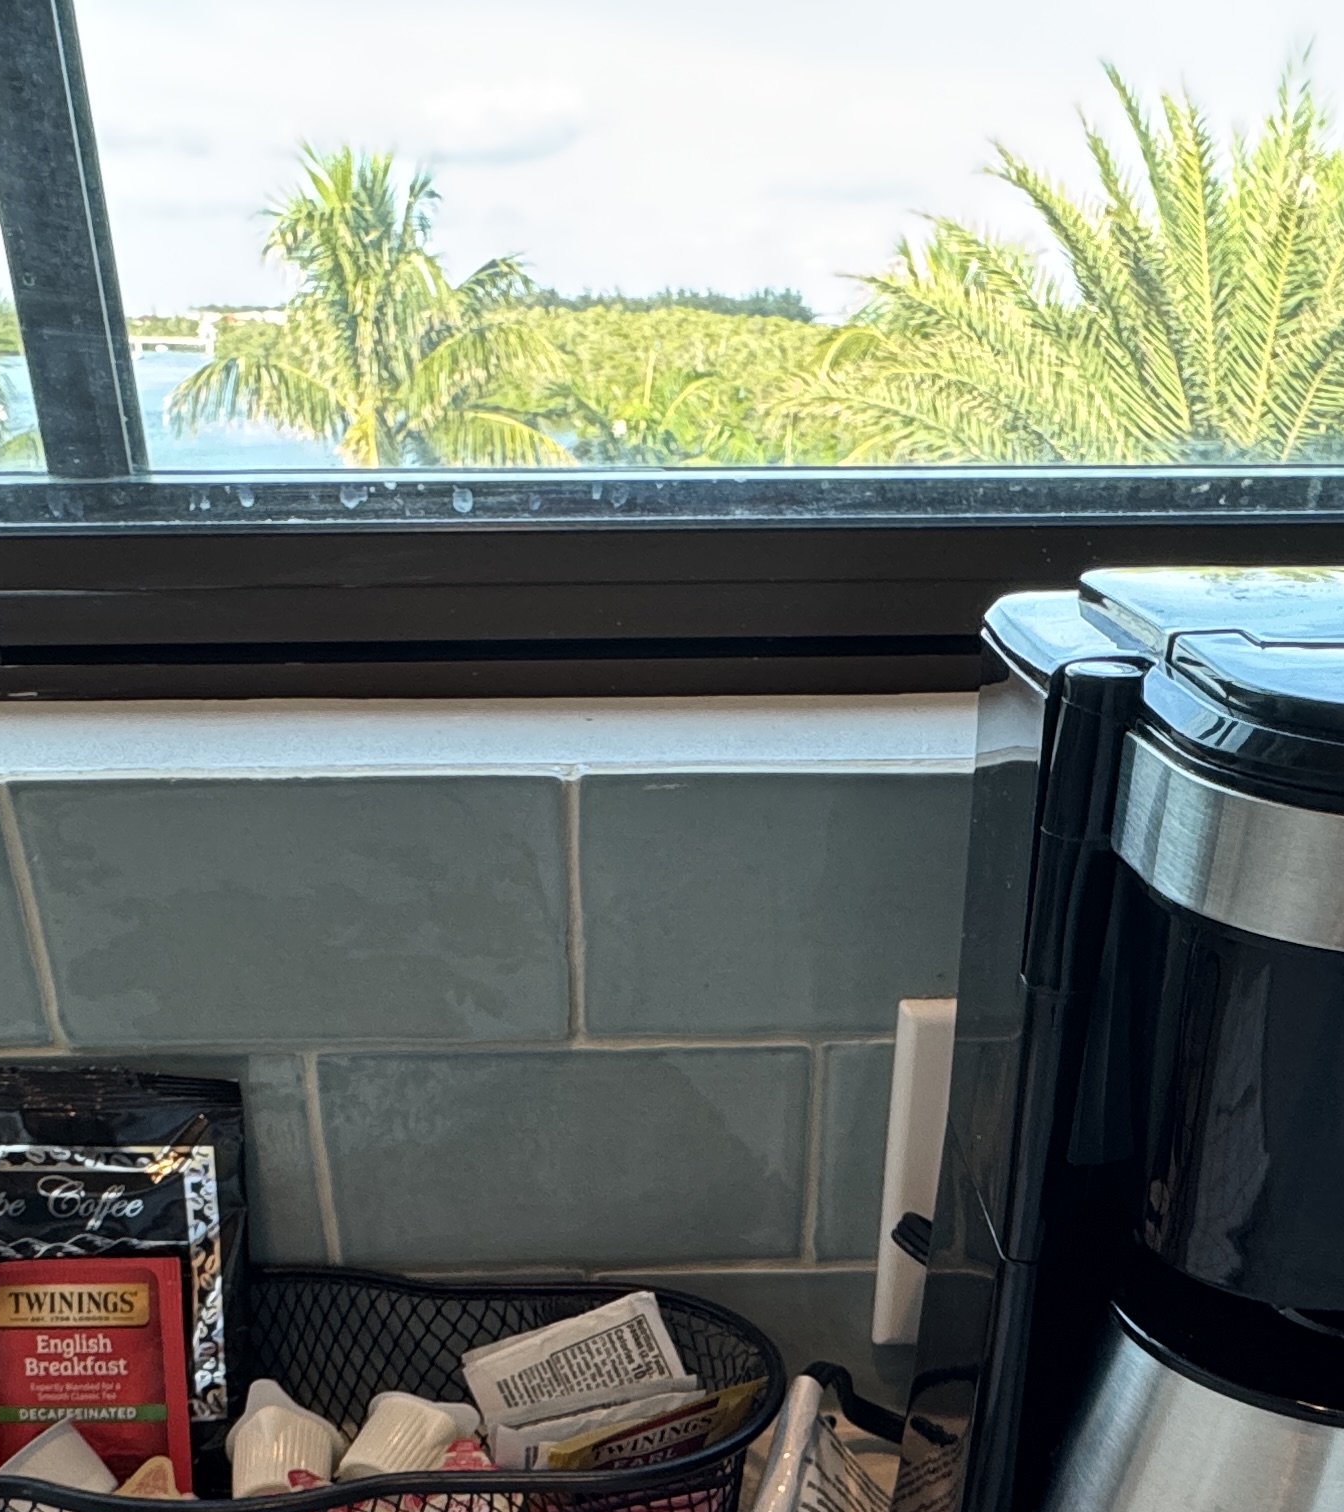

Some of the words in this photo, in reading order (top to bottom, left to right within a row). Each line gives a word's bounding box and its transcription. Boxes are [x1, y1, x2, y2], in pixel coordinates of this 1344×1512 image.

[37, 1175, 145, 1231] Coffee
[8, 1290, 136, 1314] TWININGS
[36, 1333, 113, 1358] English
[24, 1356, 128, 1376] Breakfast
[19, 1407, 137, 1421] DECAFFEINATED
